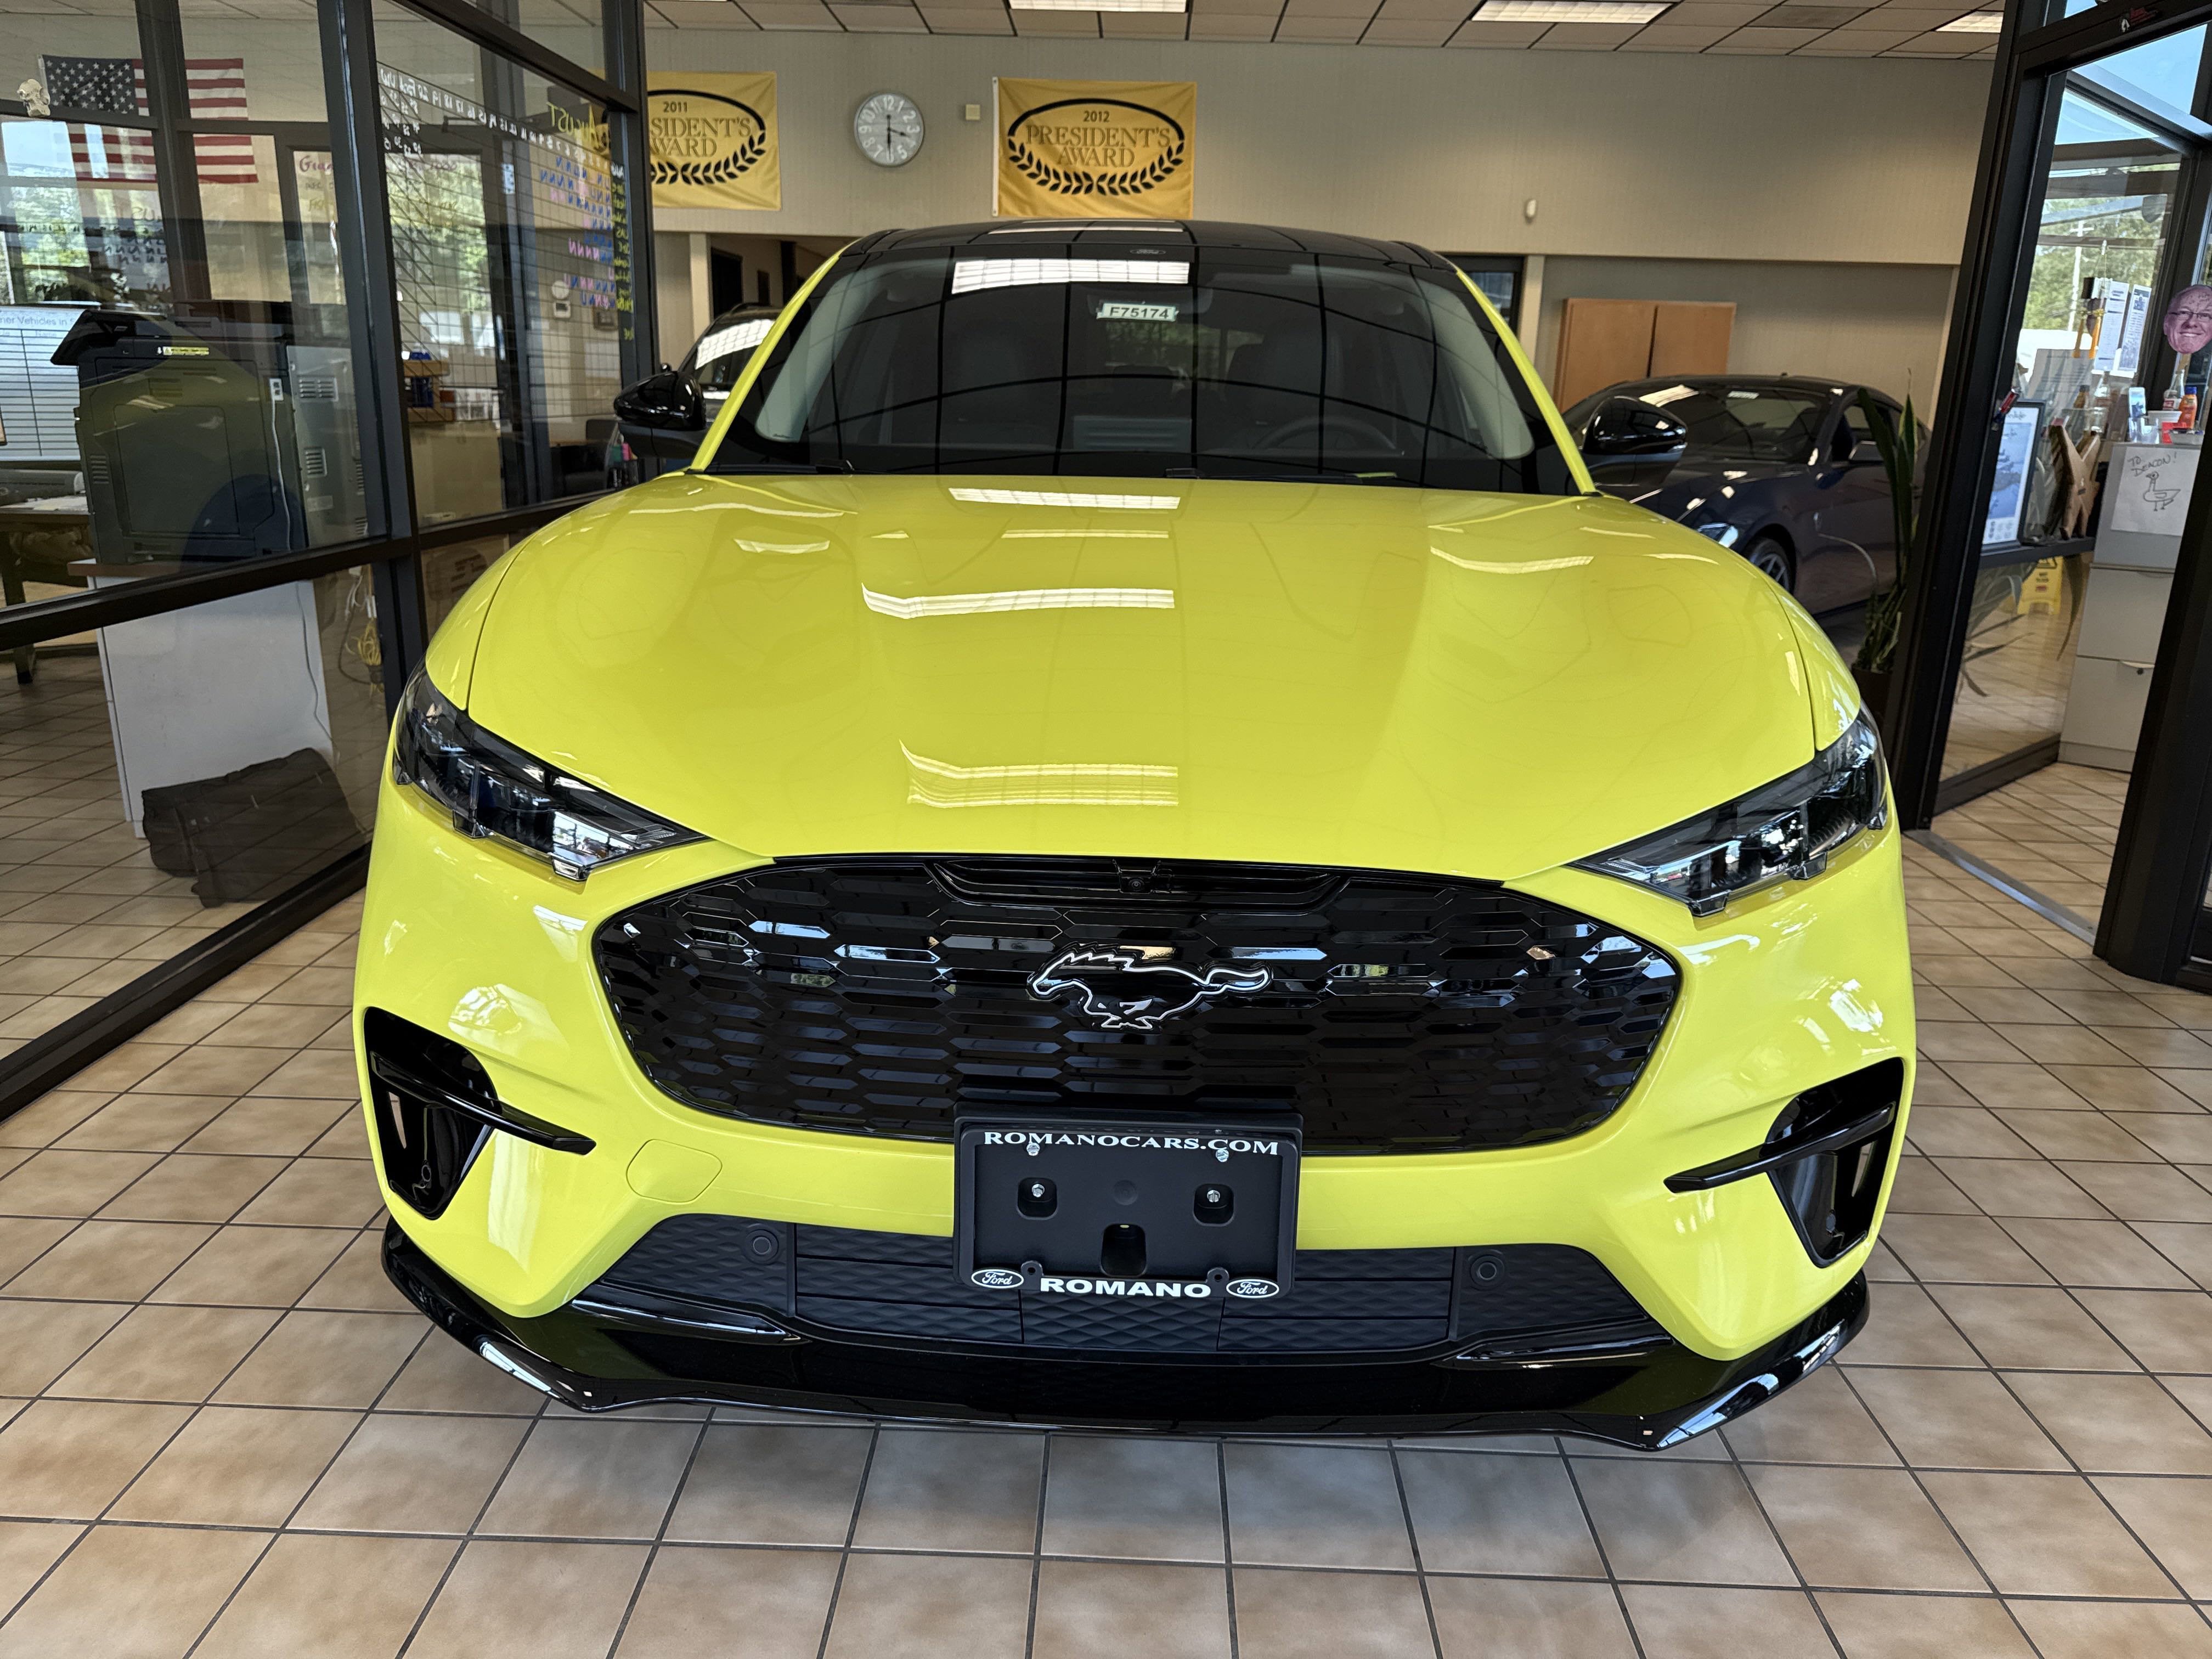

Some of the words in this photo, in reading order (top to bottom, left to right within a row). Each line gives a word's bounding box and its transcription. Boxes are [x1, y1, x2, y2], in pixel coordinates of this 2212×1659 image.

[663, 101, 688, 113] 2011
[883, 95, 895, 110] 12
[898, 99, 905, 114] 1
[902, 110, 916, 123] 2
[1083, 111, 1110, 123] 2012
[650, 116, 752, 138] SIDENT'S
[859, 125, 872, 133] 9
[906, 125, 921, 133] 3
[863, 137, 876, 148] 8
[1025, 124, 1171, 148] PRESIDENT'S
[650, 137, 717, 157] WARD
[873, 144, 884, 159] 7
[897, 145, 907, 160] 5
[1057, 146, 1135, 167] AWARD
[18, 315, 57, 325] Vehicles
[1109, 307, 1169, 319] F75174
[984, 1132, 1278, 1155] ROMANOCARS.COM
[981, 1271, 1013, 1285] Ford
[1040, 1277, 1211, 1298] ROMANO
[1237, 1281, 1268, 1295] Ford
